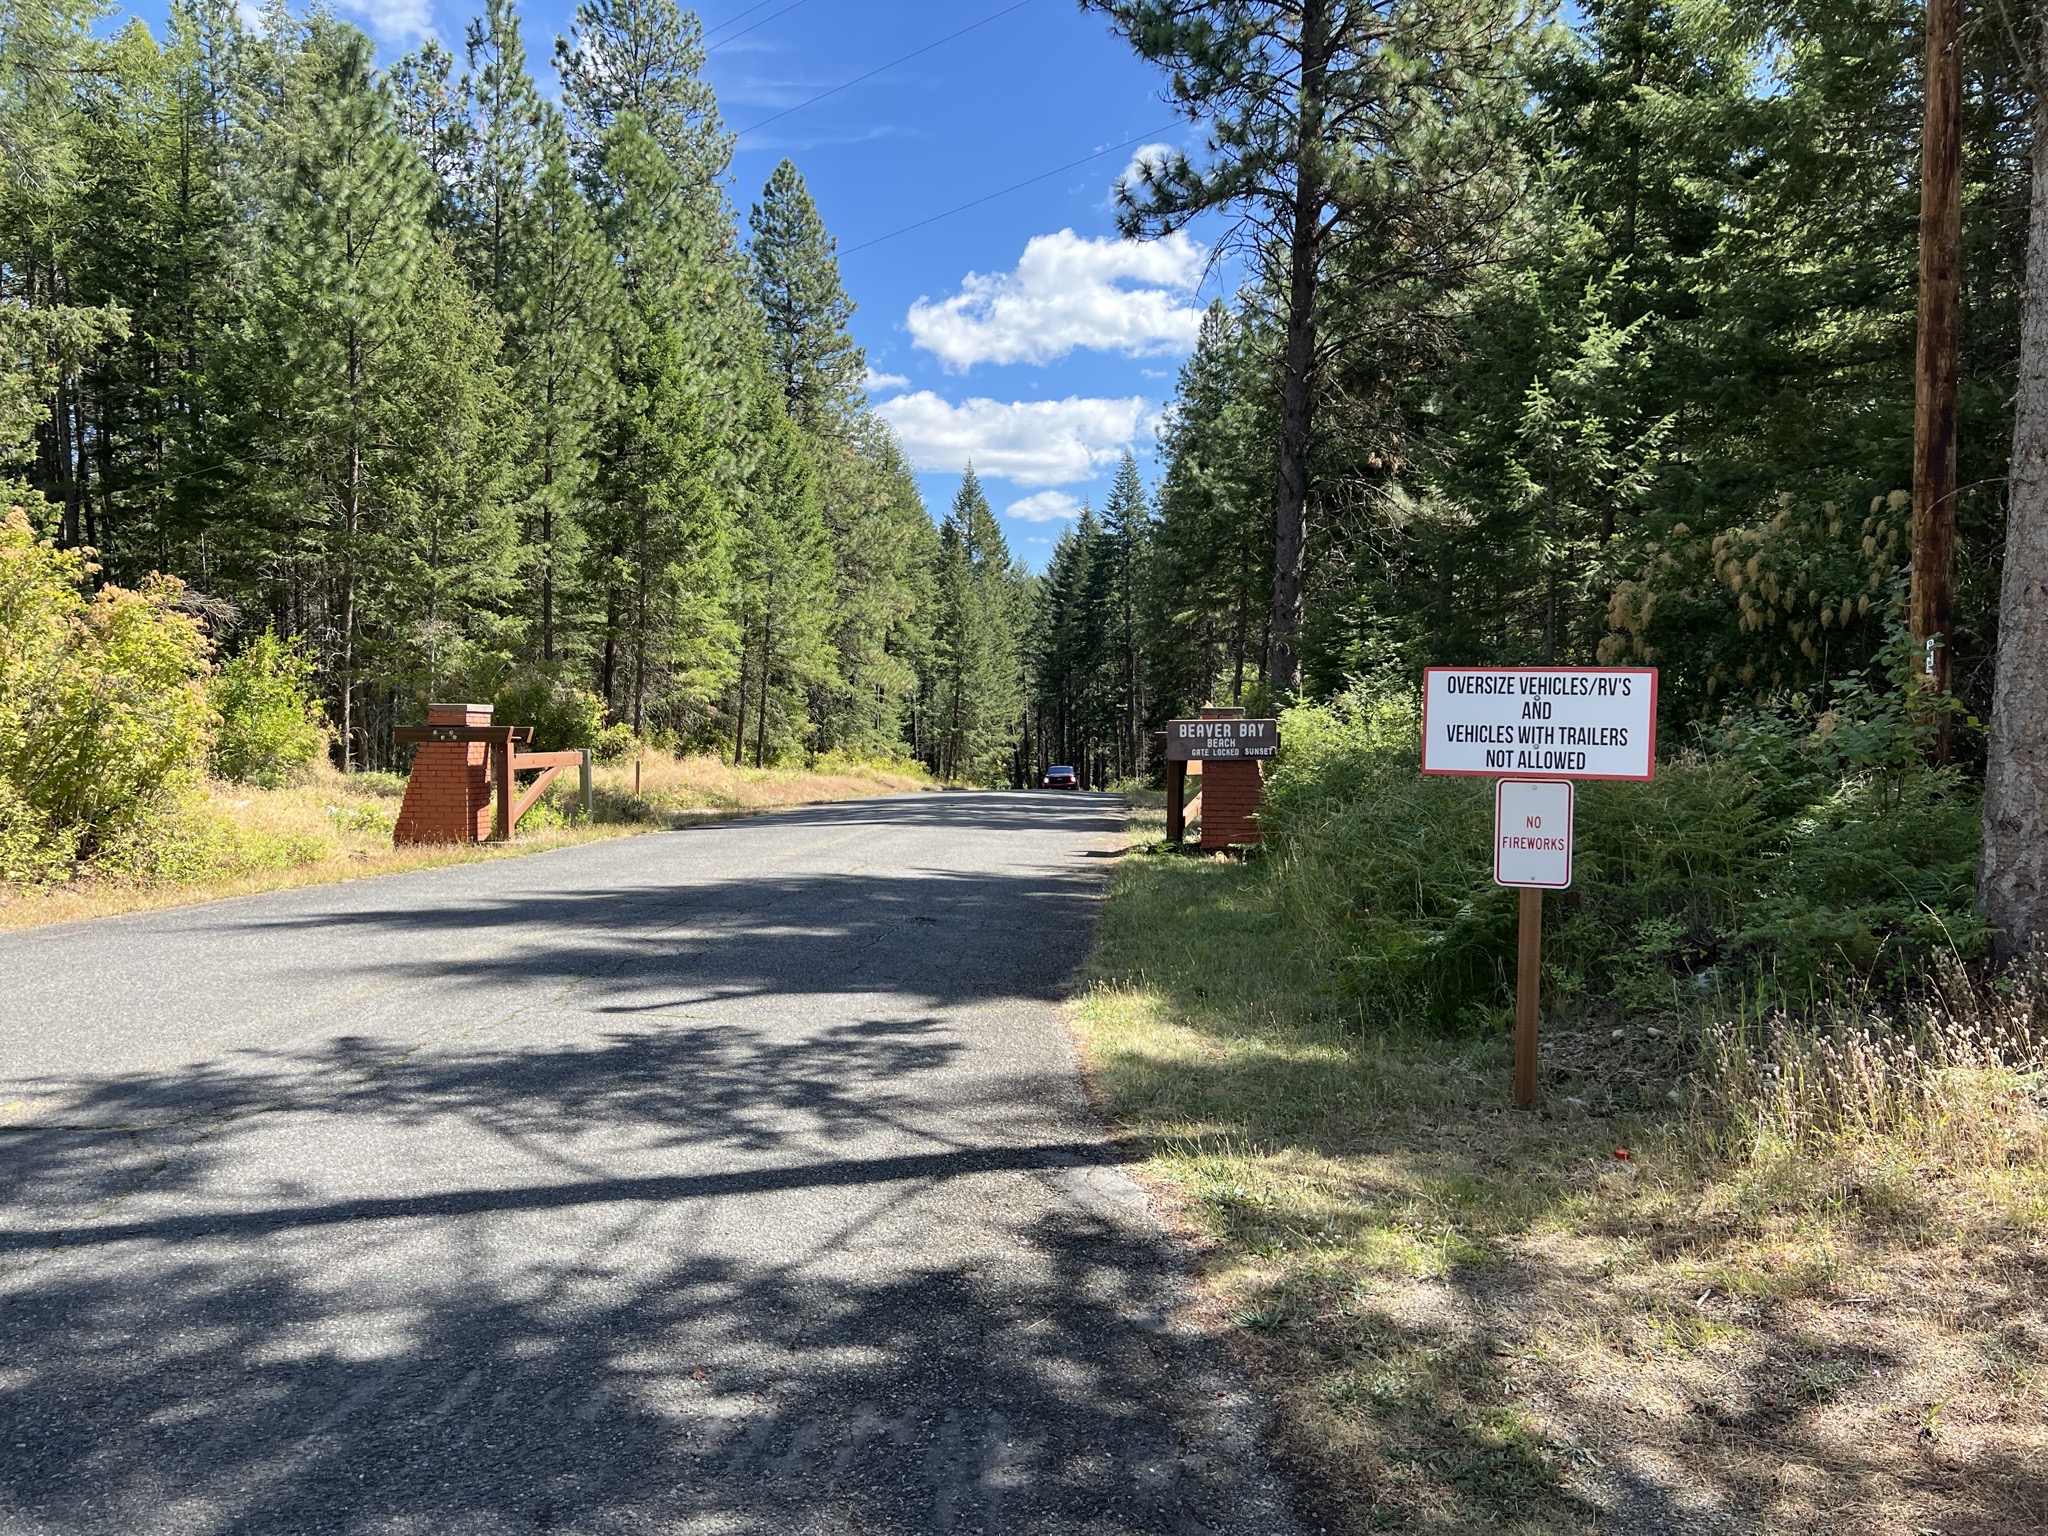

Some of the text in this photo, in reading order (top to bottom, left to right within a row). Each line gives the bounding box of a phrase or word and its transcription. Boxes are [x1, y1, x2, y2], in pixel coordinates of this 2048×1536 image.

[1447, 676, 1631, 696] OVERSIZE VEHICLES/RV'S
[1522, 701, 1552, 720] AND
[1179, 723, 1264, 738] BEAVER BAY
[1446, 725, 1628, 746] VEHICLES WITH TRAILERS
[1207, 738, 1236, 748] BEACH
[1191, 747, 1273, 757] GATE LOCKED SUNSET
[1486, 750, 1586, 770] NOT ALLOWED
[1526, 816, 1542, 829] NO
[1502, 836, 1565, 851] FIREWORKS
